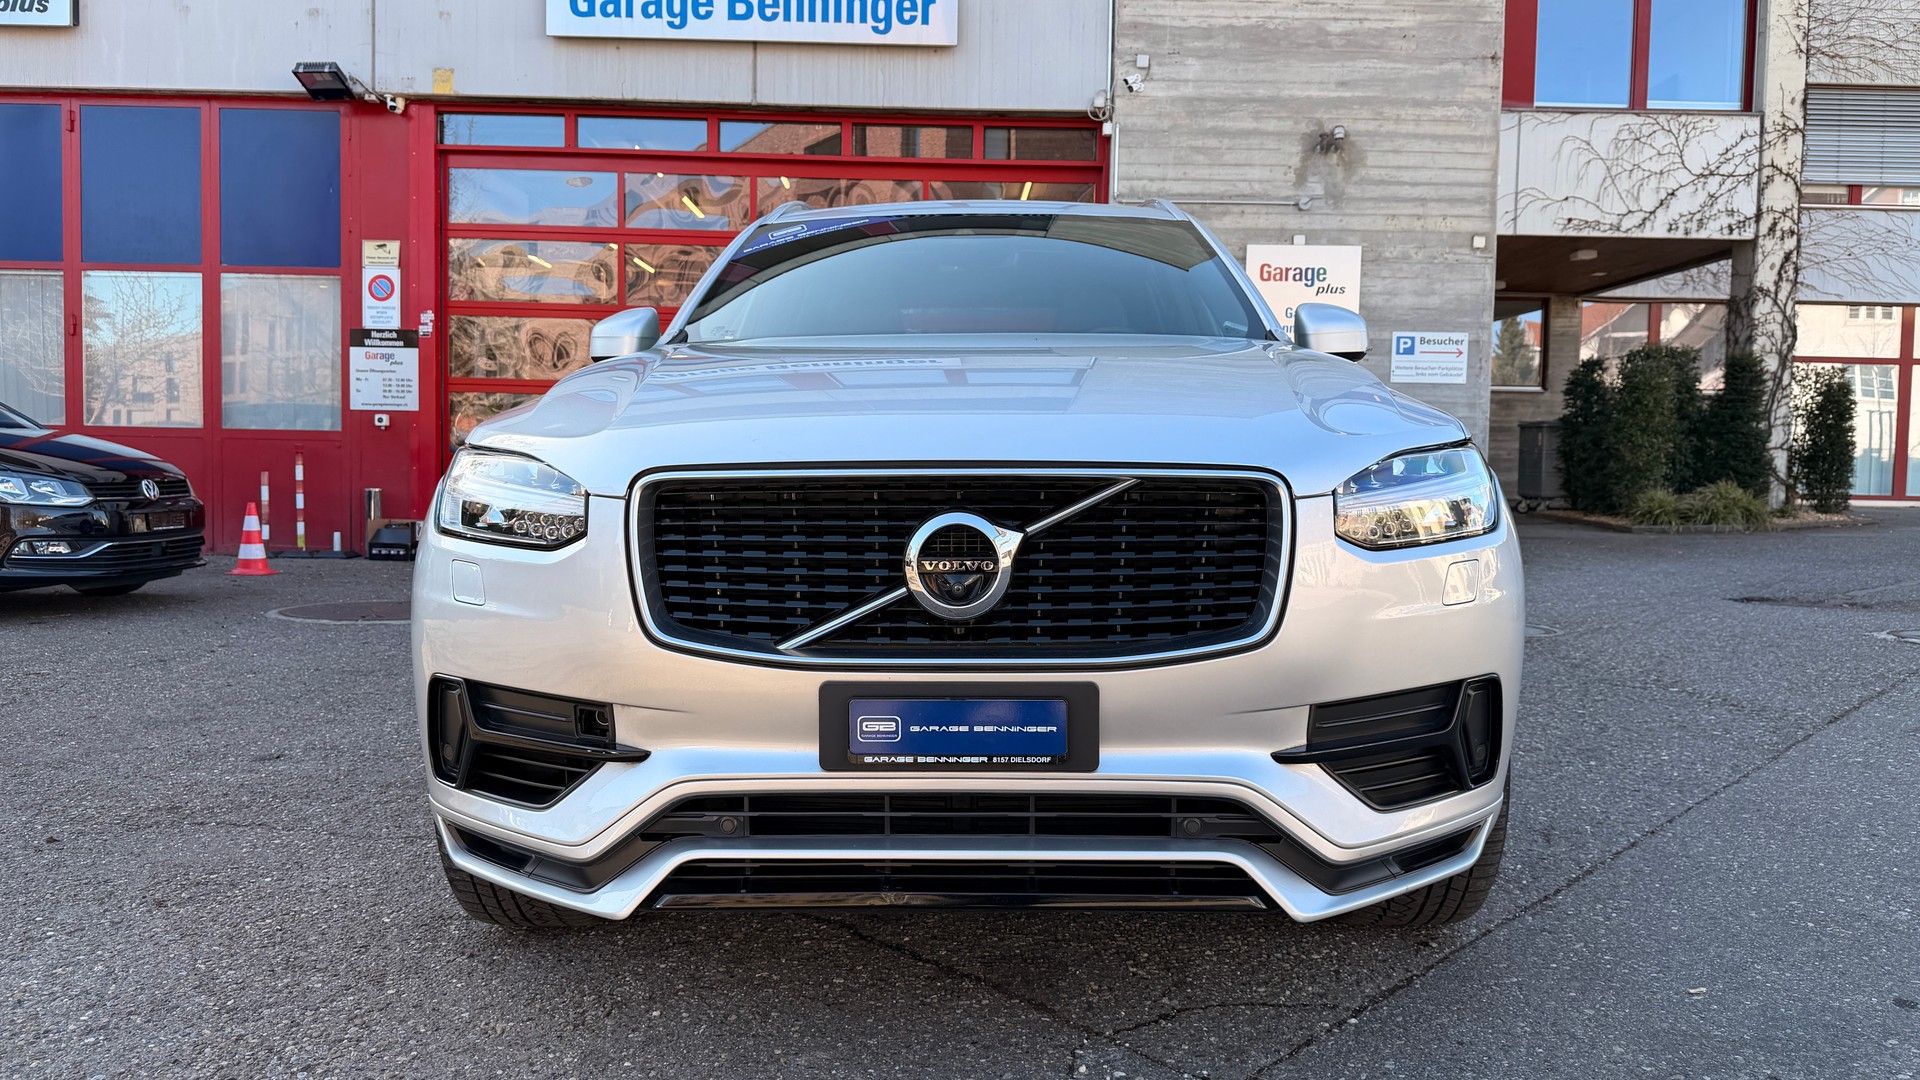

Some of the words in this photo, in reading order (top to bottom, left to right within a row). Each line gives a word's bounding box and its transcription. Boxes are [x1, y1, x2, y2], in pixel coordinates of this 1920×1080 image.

[1260, 263, 1327, 288] Garage
[1315, 284, 1347, 296] plus
[371, 331, 397, 339] Herzlich
[364, 339, 404, 347] Willkommen
[1399, 338, 1412, 354] P
[1420, 336, 1465, 346] Besucher
[365, 351, 395, 363] Garage
[921, 560, 994, 571] VOLVO
[862, 721, 897, 732] GB
